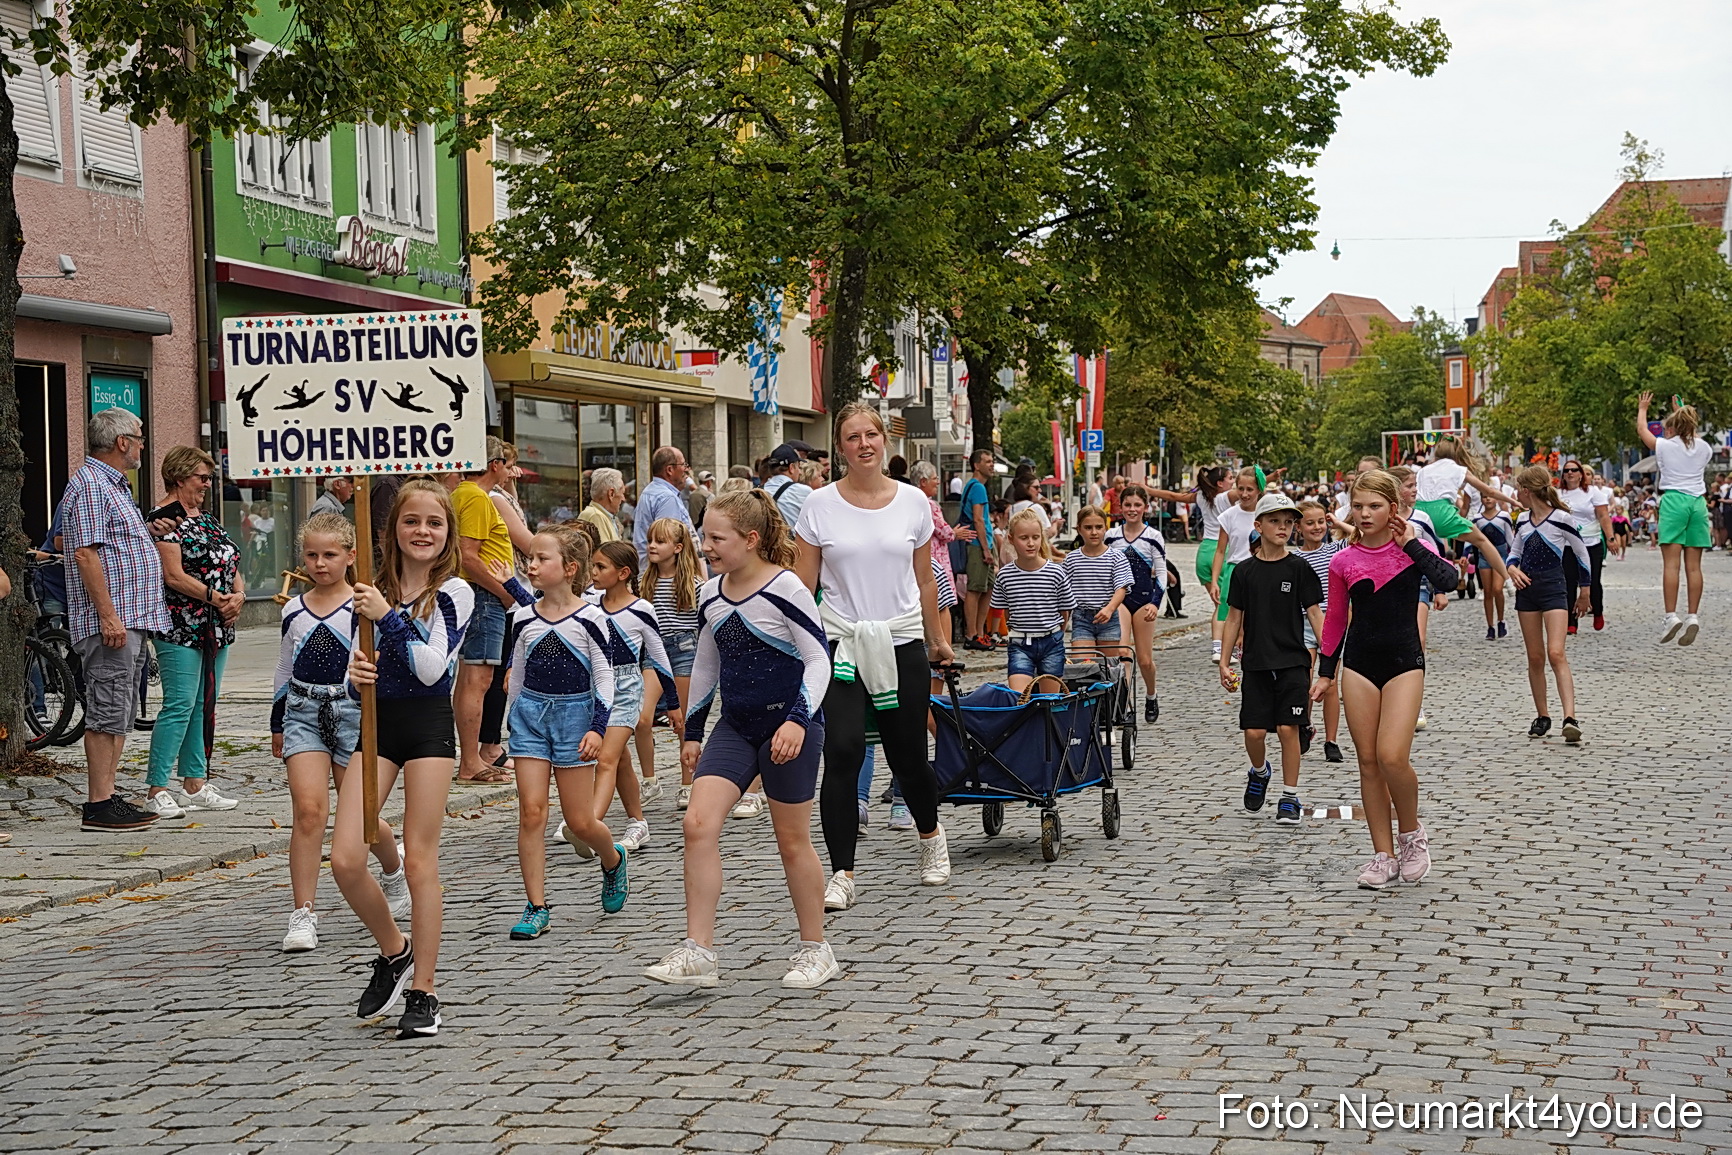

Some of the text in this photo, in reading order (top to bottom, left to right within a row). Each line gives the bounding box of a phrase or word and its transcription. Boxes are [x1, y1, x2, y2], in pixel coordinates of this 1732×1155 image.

[285, 235, 336, 262] METZGEREI
[344, 215, 410, 279] Bögerl
[227, 324, 478, 366] TURNABTEILUNG
[564, 316, 603, 359] LEDER
[695, 368, 714, 377] family
[94, 384, 135, 408] Essig Öl
[334, 378, 378, 413] SV
[257, 419, 454, 463] HÖHENBERG
[1087, 432, 1099, 449] P
